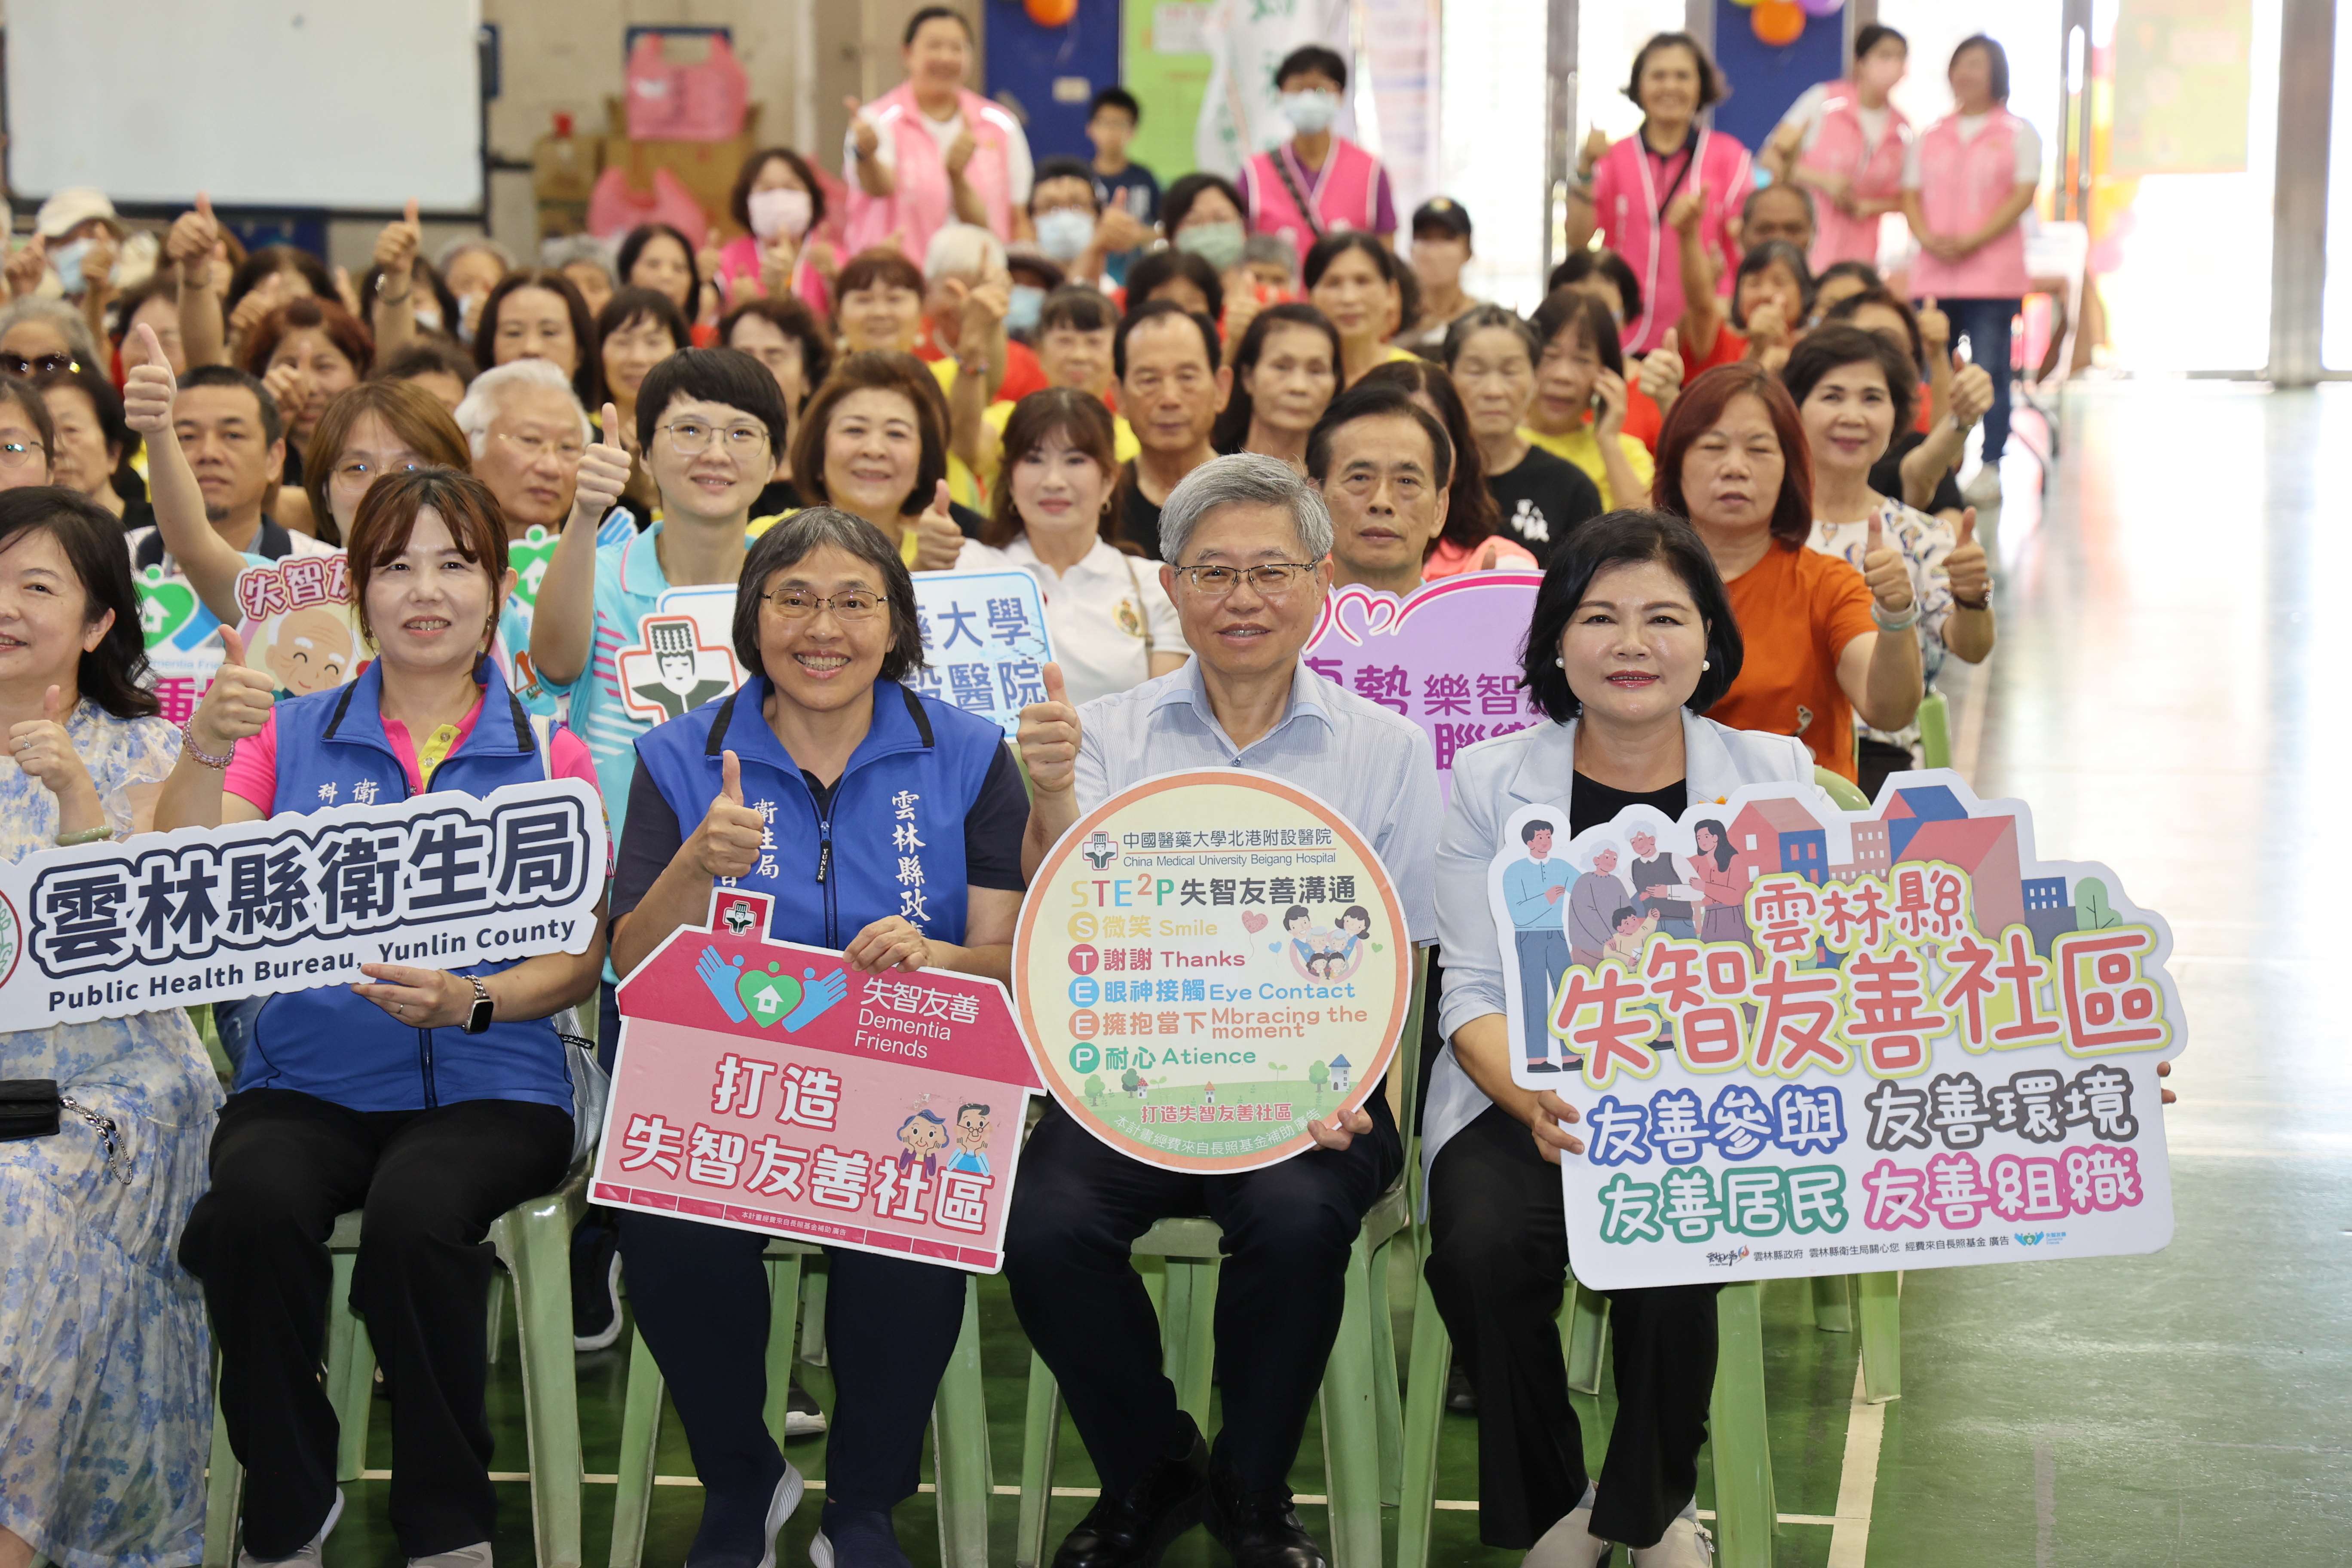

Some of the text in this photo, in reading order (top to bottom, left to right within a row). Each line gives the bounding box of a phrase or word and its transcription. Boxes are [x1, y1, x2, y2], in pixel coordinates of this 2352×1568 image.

[1424, 673, 1548, 717] 樂智
[1435, 722, 1537, 770] 腦
[318, 781, 338, 804] 科
[352, 778, 380, 805] 衛
[752, 798, 779, 879] 衛生局
[1123, 829, 1332, 848] 中國醫藥大學北港附設醫院
[818, 848, 828, 880] YUNLIN
[1123, 852, 1336, 867] China Medical University Beigang Hospital
[46, 813, 574, 964] 雲林縣衛生局
[1180, 875, 1356, 906] 失智友善溝通
[1103, 915, 1152, 938] 微笑
[1159, 919, 1217, 936] Smile
[1754, 871, 1963, 953] 雲林縣
[49, 919, 576, 1012] Public Health Bureau, Yunlin County
[1104, 947, 1152, 971] 謝謝
[1161, 949, 1245, 968] Thanks
[860, 977, 980, 1025] 失智友善
[1105, 979, 1205, 1003] 眼神接觸
[1210, 984, 1252, 1002] Eye
[1259, 982, 1355, 999] Contact
[1558, 930, 2162, 1081] 失智友善社區
[859, 1009, 951, 1041] Dementia
[1103, 1011, 1207, 1036] 擁抱當下
[1212, 1008, 1320, 1026] Mbracing
[1328, 1006, 1367, 1023] the
[1213, 1023, 1305, 1038] moment
[562, 1036, 591, 1048] UNLIN
[854, 1030, 928, 1059] Friends
[1106, 1046, 1156, 1070] 耐心
[1162, 1048, 1256, 1065] Atience
[715, 1056, 839, 1130] 打造
[1141, 1103, 1292, 1124] 打造失智友善社區
[1591, 1070, 2134, 1163] 友善參與 友善環境
[1114, 1108, 1320, 1155] 本計畫經費來自長照基金補助 廣告
[622, 1115, 992, 1233] 失智友善社區
[1605, 1148, 2139, 1241] 友善居民 友善組織
[741, 1211, 846, 1236] 本計畫經費來自長照基金補助 廣告
[1754, 1236, 2009, 1262] 雲林縣政府 雲林縣衛生局關心您 經費來自長照基金 廣告
